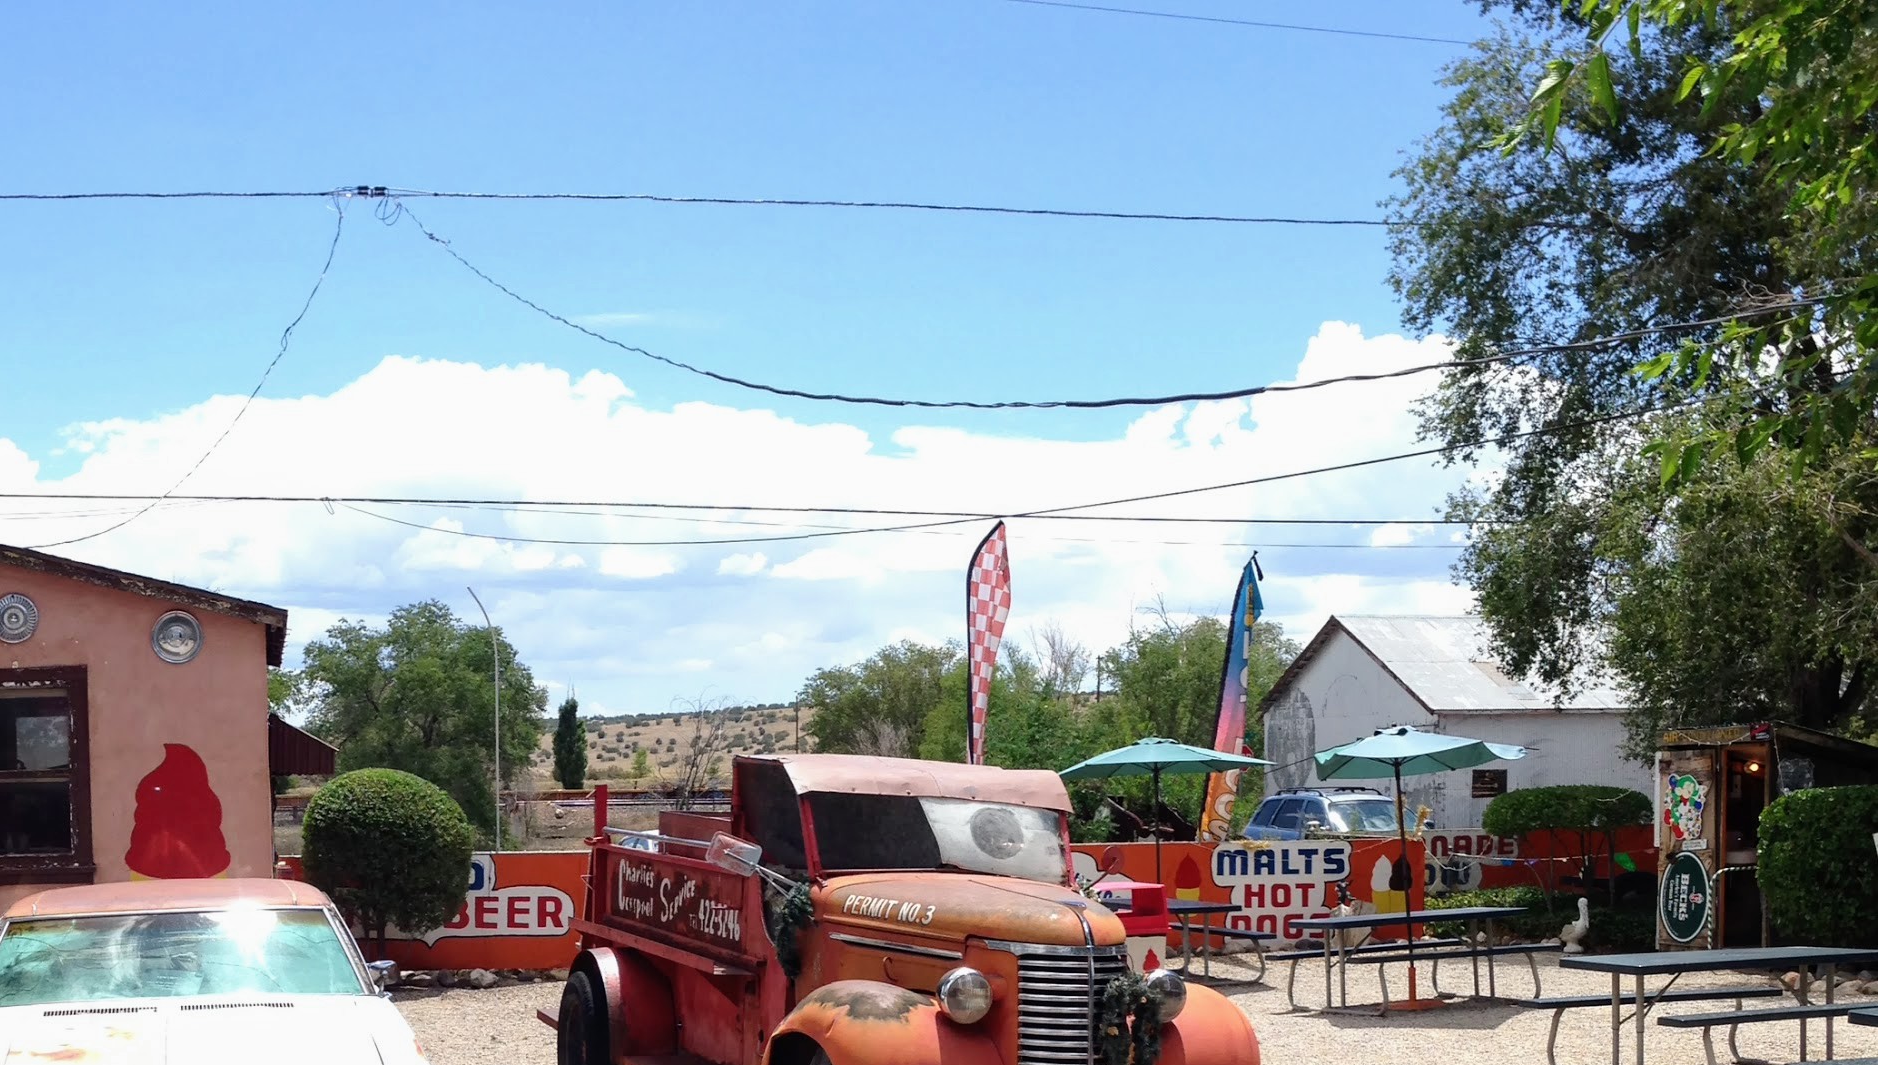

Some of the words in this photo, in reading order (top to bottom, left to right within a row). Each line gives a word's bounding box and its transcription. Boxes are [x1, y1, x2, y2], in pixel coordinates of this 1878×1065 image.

[1430, 834, 1516, 857] NADE
[1216, 848, 1346, 876] MALTS
[843, 894, 899, 920] PERMIT
[1243, 883, 1316, 909] HOT
[443, 896, 565, 929] BEER
